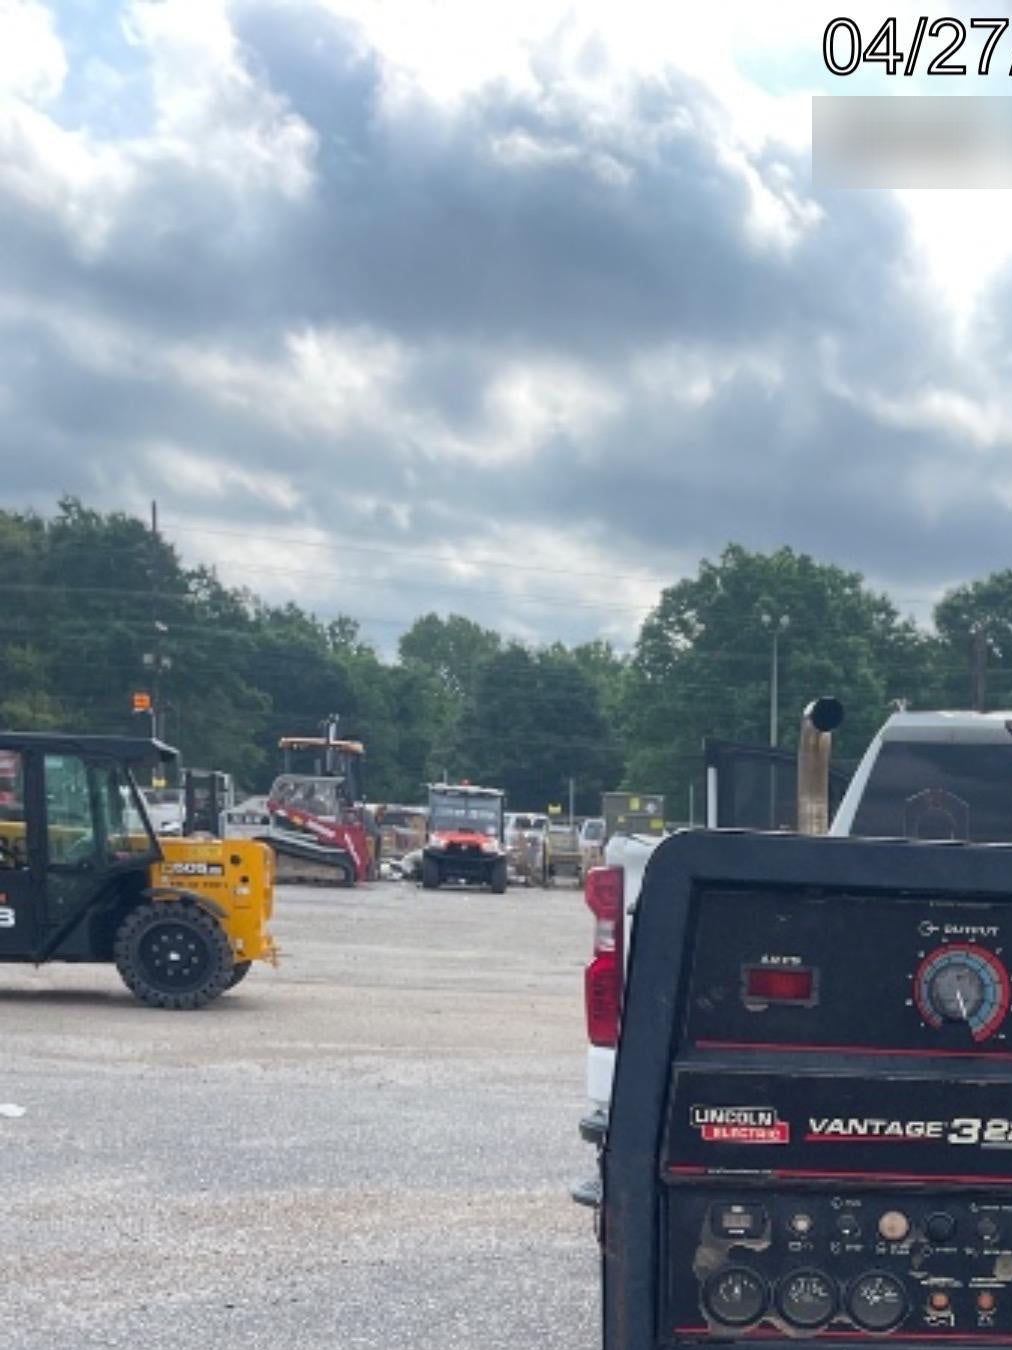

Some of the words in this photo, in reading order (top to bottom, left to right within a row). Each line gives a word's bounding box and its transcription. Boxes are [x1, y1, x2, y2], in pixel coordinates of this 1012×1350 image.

[694, 1108, 773, 1126] LINCOLN
[712, 1127, 782, 1140] ELECTRIC
[808, 1117, 945, 1139] VANTAGE
